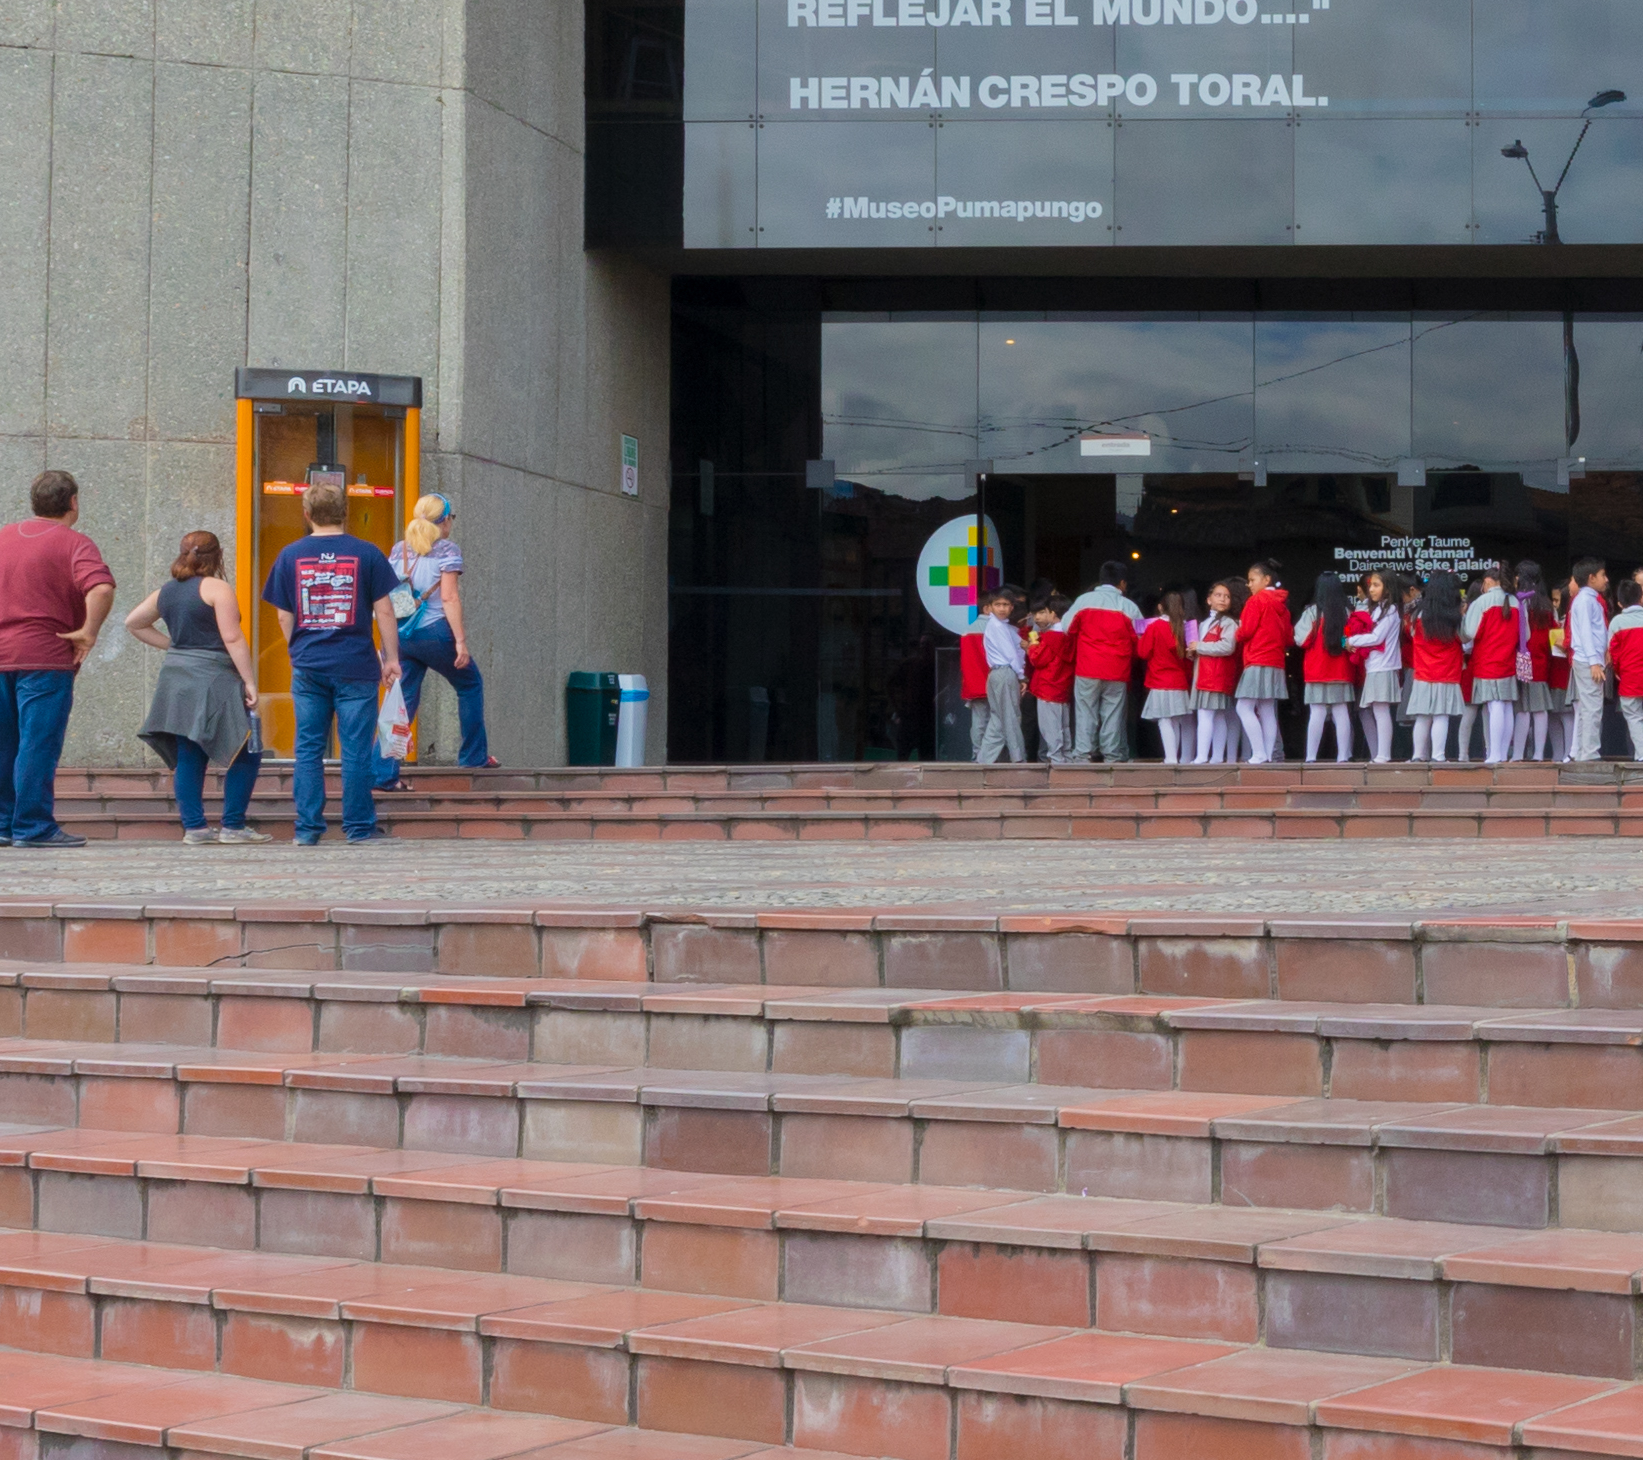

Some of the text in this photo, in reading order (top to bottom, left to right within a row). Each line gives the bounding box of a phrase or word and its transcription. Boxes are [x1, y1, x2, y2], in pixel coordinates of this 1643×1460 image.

[789, 68, 1329, 109] HERNÁN CRESPO TORAL.
[825, 196, 1103, 223] #MuseoPumapungo
[312, 378, 372, 396] ETAPA
[1428, 535, 1470, 547] Taume
[1334, 547, 1405, 559] Benvenuti
[1415, 559, 1450, 571] Seke
